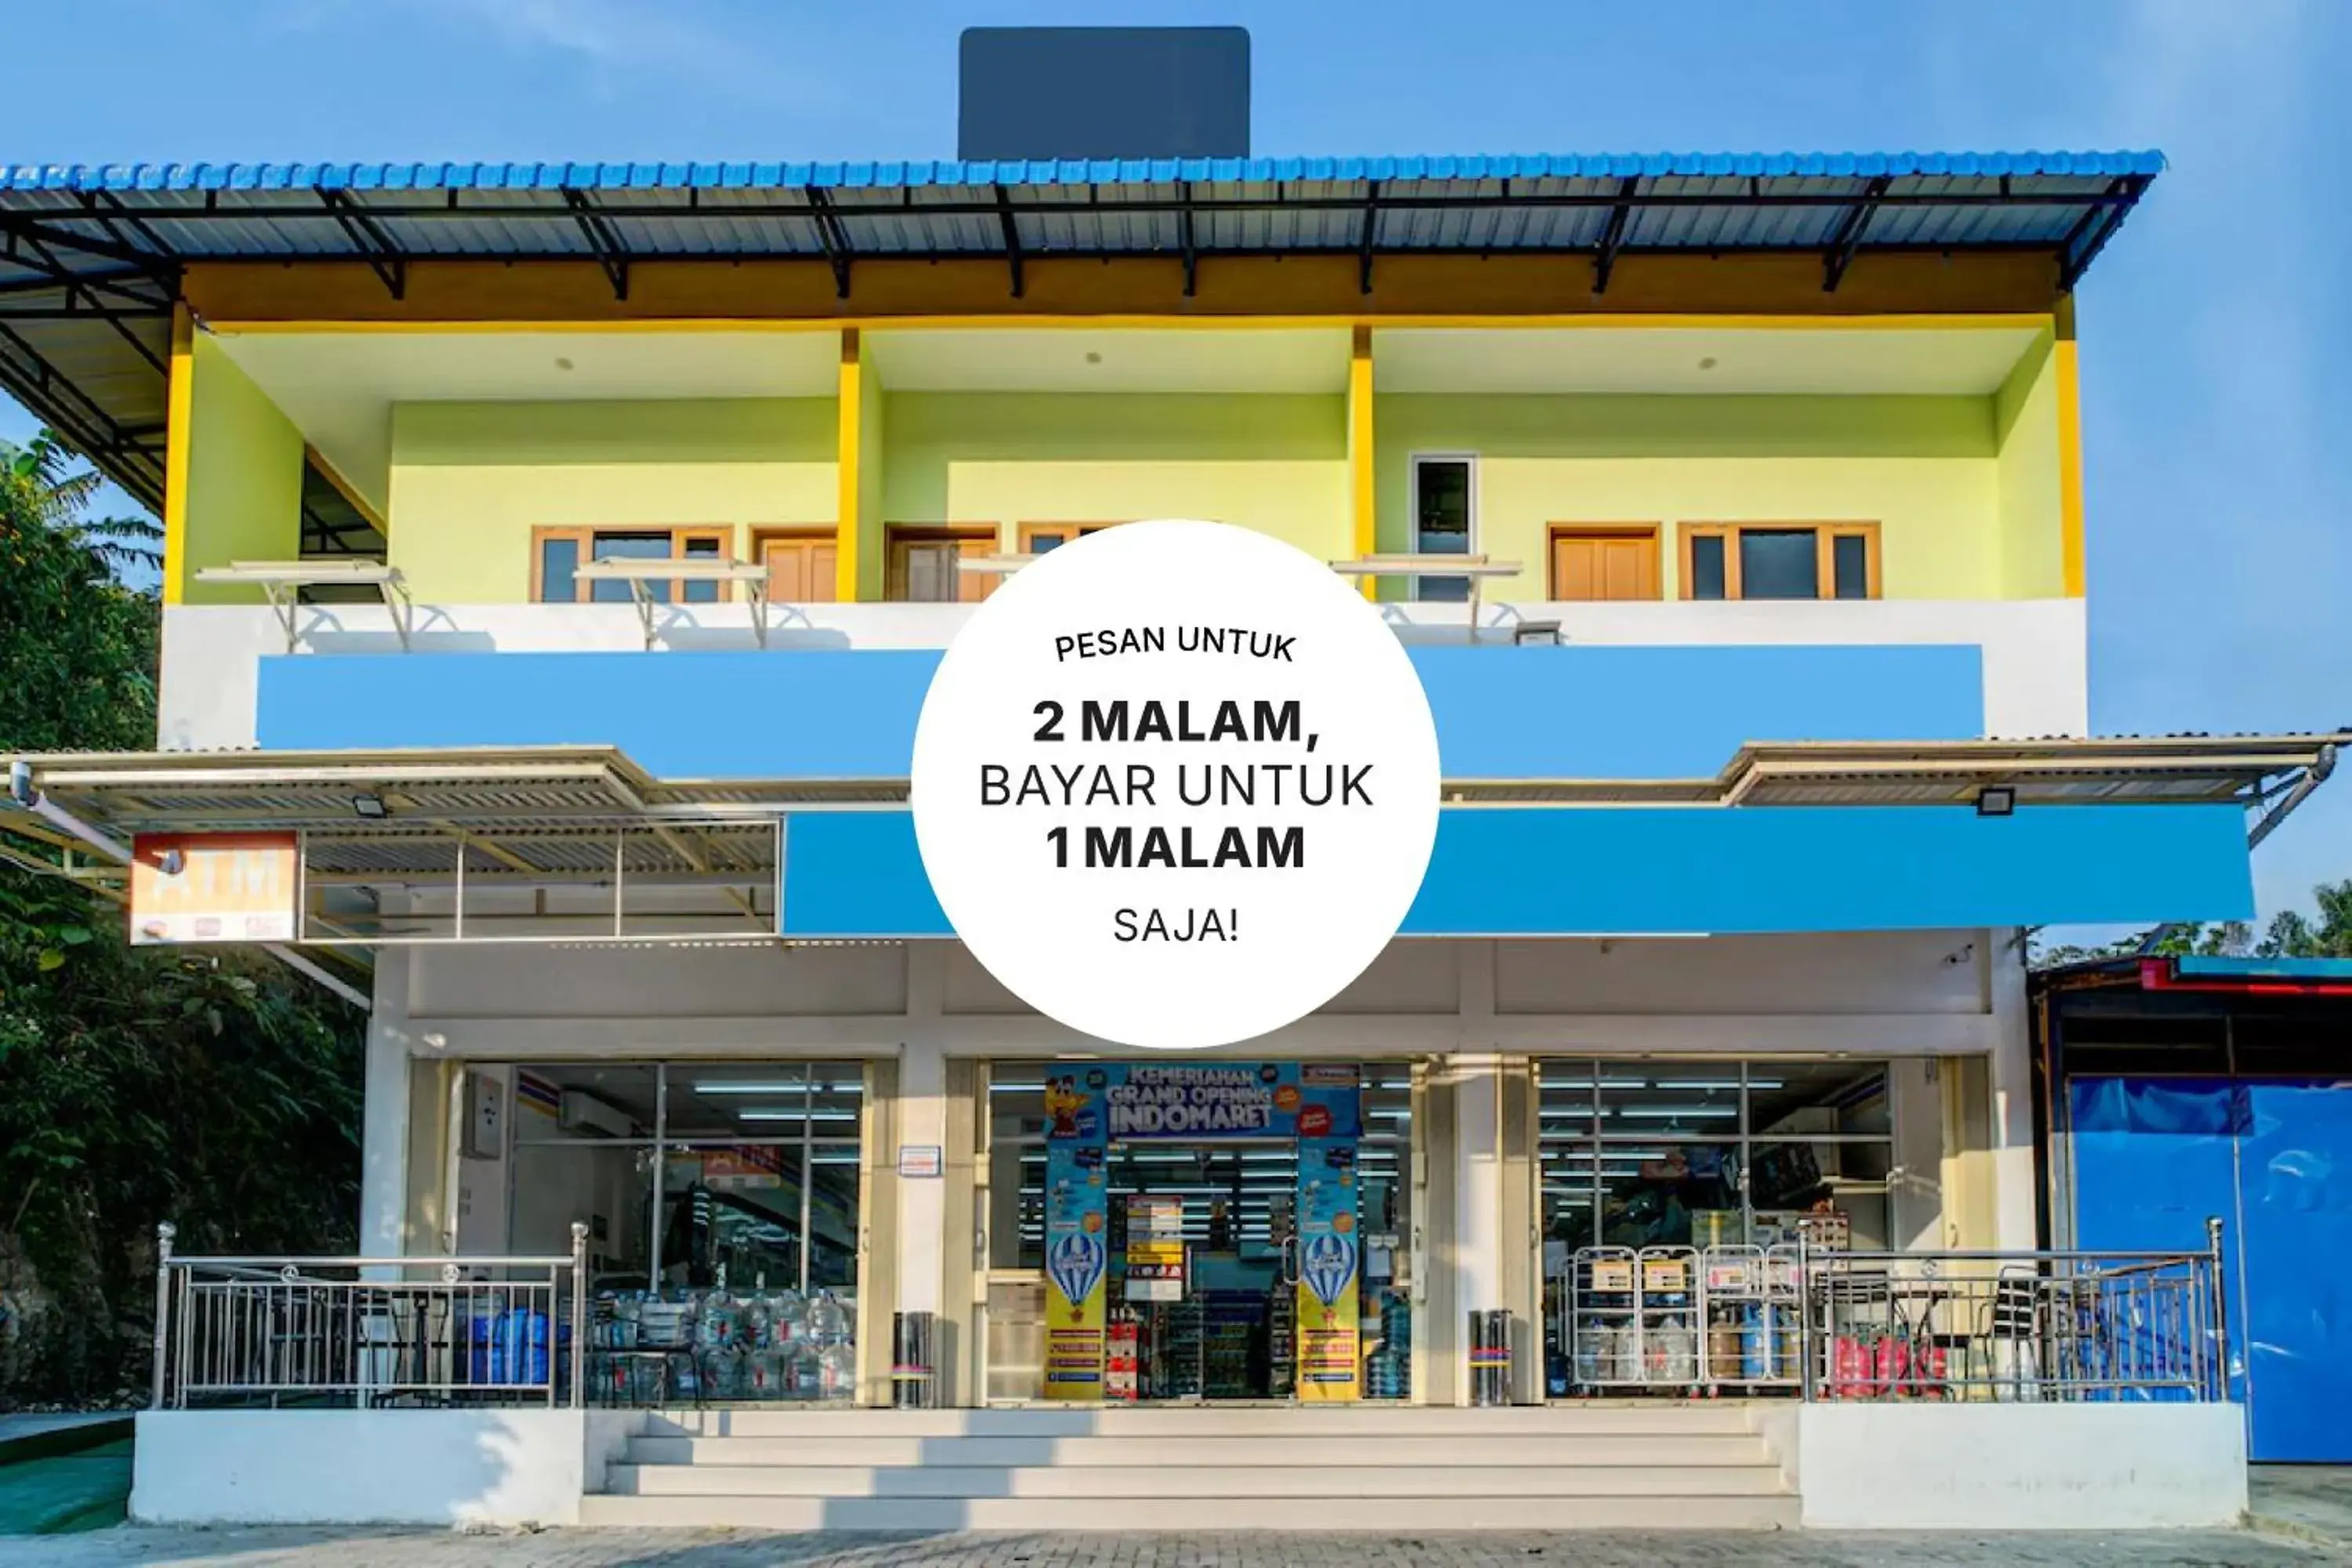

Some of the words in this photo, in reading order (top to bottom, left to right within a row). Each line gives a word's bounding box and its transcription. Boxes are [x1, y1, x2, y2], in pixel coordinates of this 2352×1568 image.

[152, 849, 280, 899] ATM
[1106, 1086, 1186, 1104] GRAND
[1191, 1087, 1272, 1105] OPENING
[1109, 1104, 1272, 1133] INDOMARET
